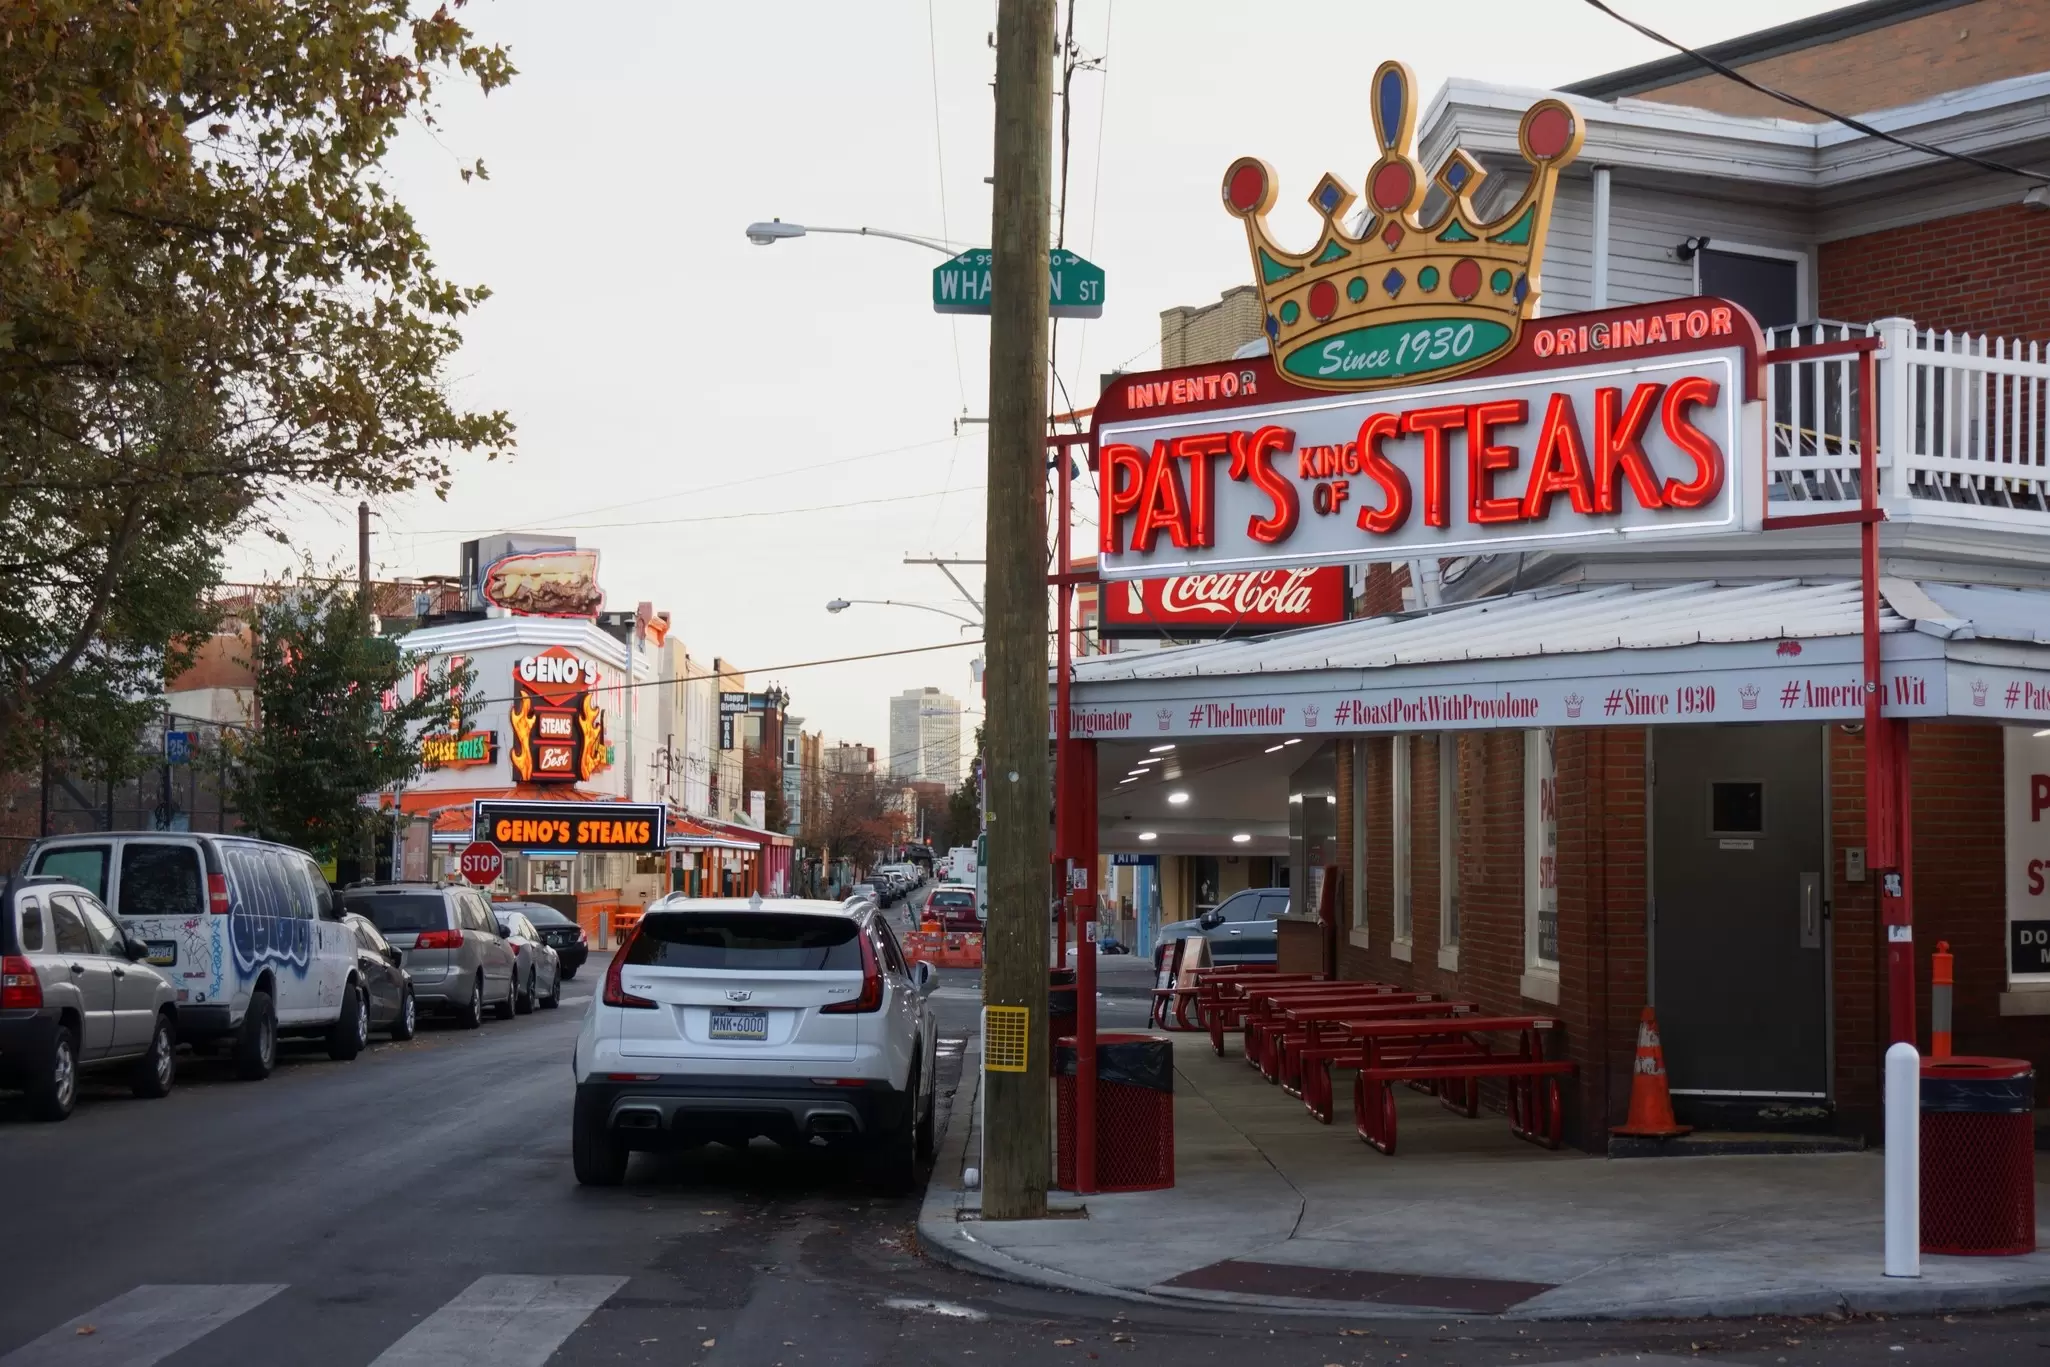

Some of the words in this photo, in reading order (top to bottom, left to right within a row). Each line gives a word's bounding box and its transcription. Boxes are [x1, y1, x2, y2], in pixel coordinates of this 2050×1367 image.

[940, 270, 1062, 300] WHAN
[1079, 280, 1098, 300] ST
[1533, 307, 1733, 358] ORIGINATOR
[1319, 340, 1391, 375] Since
[1396, 324, 1474, 366] 1930
[1127, 370, 1257, 409] INVENTOR
[1299, 440, 1358, 479] KING
[1355, 376, 1720, 534] STEAKS
[1100, 425, 1299, 554] PAT'S
[1312, 480, 1348, 516] OF
[1161, 567, 1311, 613] Coca-Cola
[520, 656, 597, 684] GENO'S
[720, 702, 748, 712] Birthday
[723, 693, 745, 702] Happy
[1604, 687, 1669, 717] #Since
[1676, 685, 1716, 714] 1930
[1780, 679, 1888, 709] #Americn
[1894, 676, 1926, 705] Wit
[1189, 702, 1285, 729] #TheInventor
[1334, 692, 1539, 726] #RoastPorkWithProvolone
[541, 718, 571, 735] STEAKS
[457, 736, 484, 760] FRIES
[541, 748, 570, 769] Best
[496, 820, 571, 843] GENO'S
[577, 821, 650, 844] STEAKS
[463, 855, 500, 872] STOP
